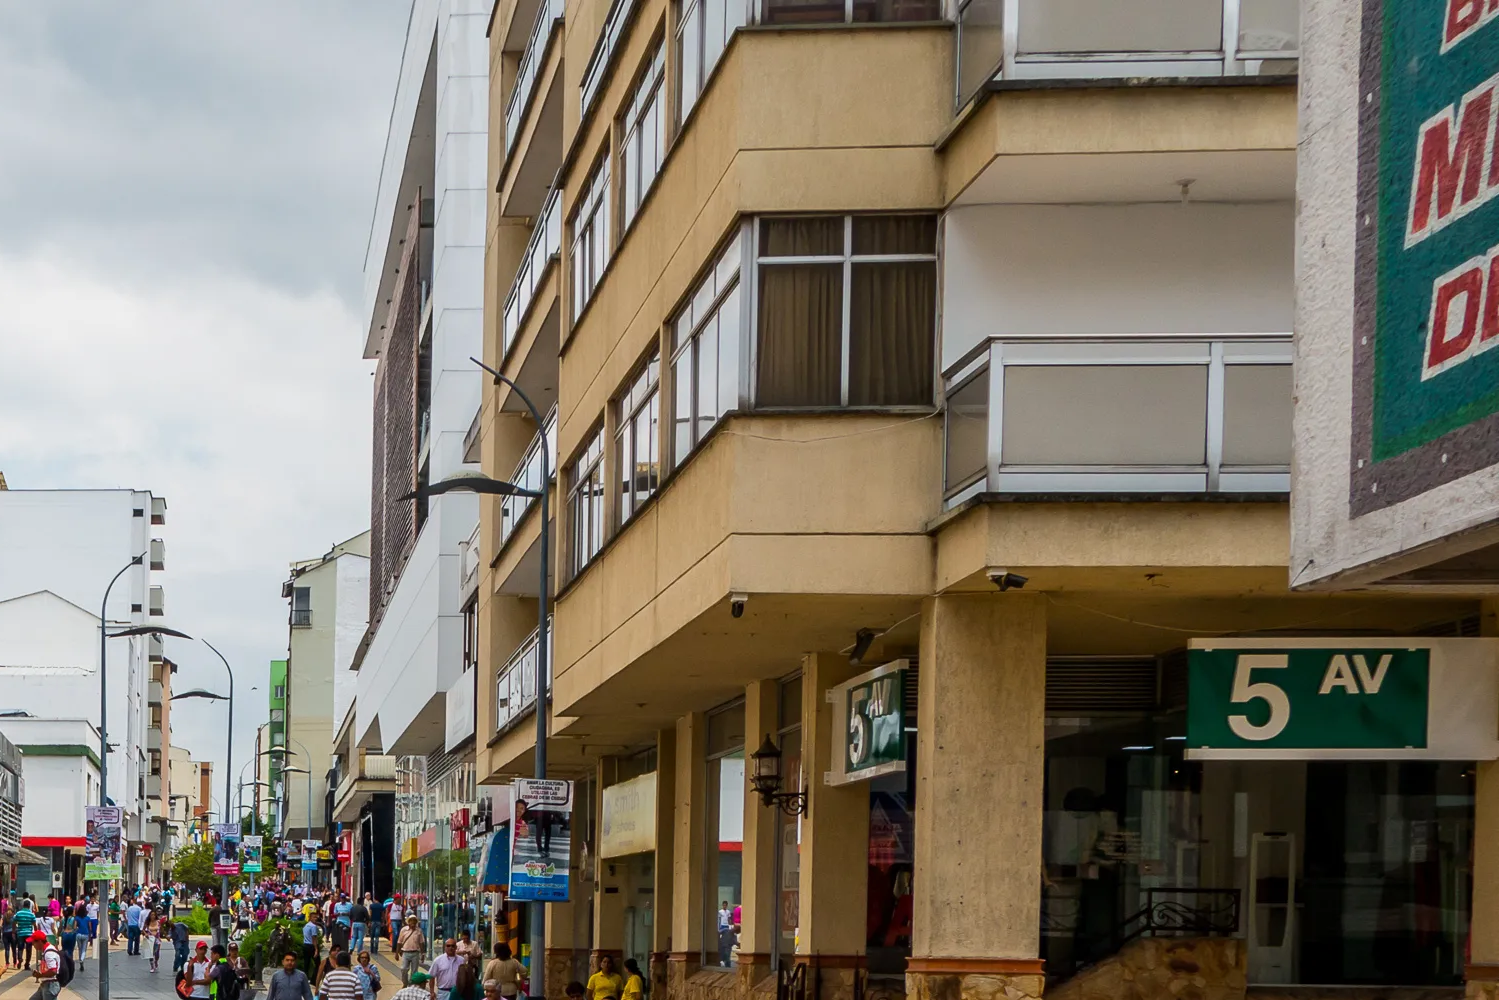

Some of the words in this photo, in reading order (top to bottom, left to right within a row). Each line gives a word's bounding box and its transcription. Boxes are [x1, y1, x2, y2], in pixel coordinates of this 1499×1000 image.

[849, 687, 866, 764] 5
[1227, 654, 1290, 741] 5
[1318, 654, 1393, 695] AV
